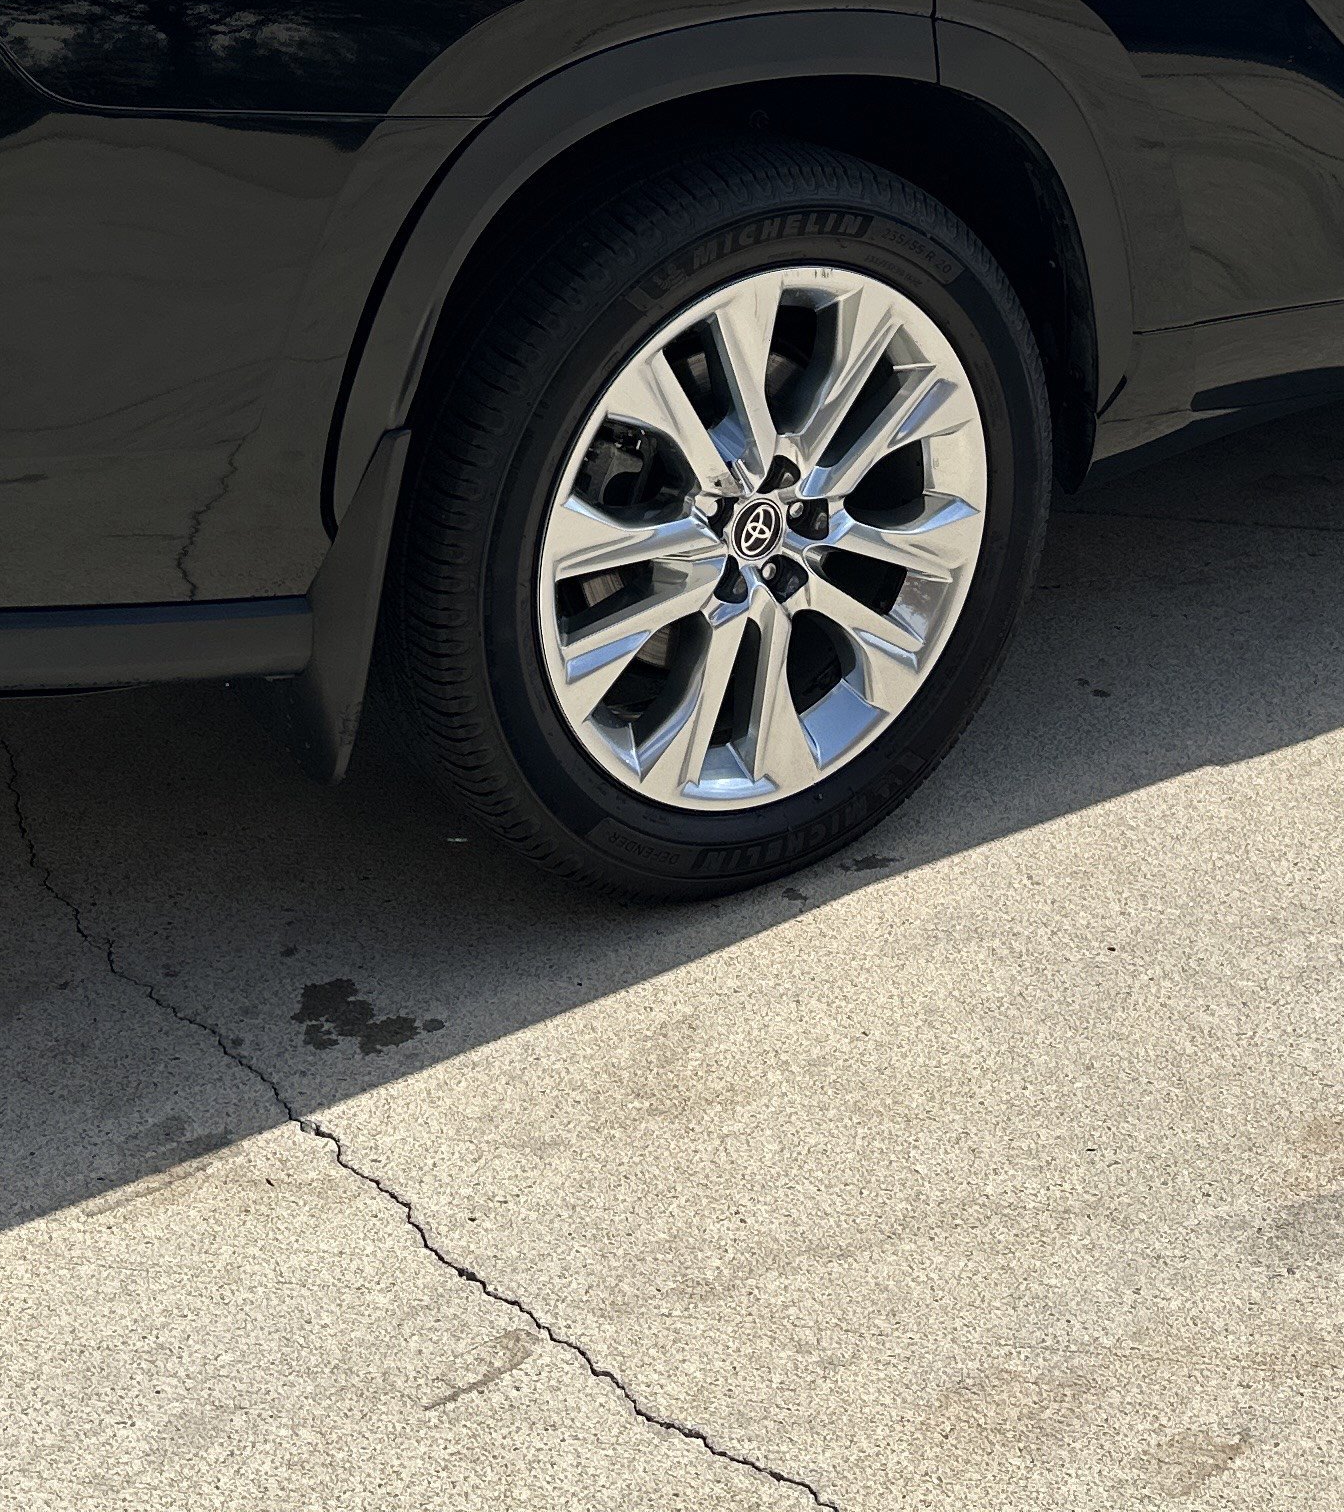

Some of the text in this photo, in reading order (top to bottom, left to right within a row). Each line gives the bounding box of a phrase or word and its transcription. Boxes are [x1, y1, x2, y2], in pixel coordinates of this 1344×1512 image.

[692, 211, 868, 271] MICHELIN
[607, 800, 869, 873] MICHELIN DEFENDER
